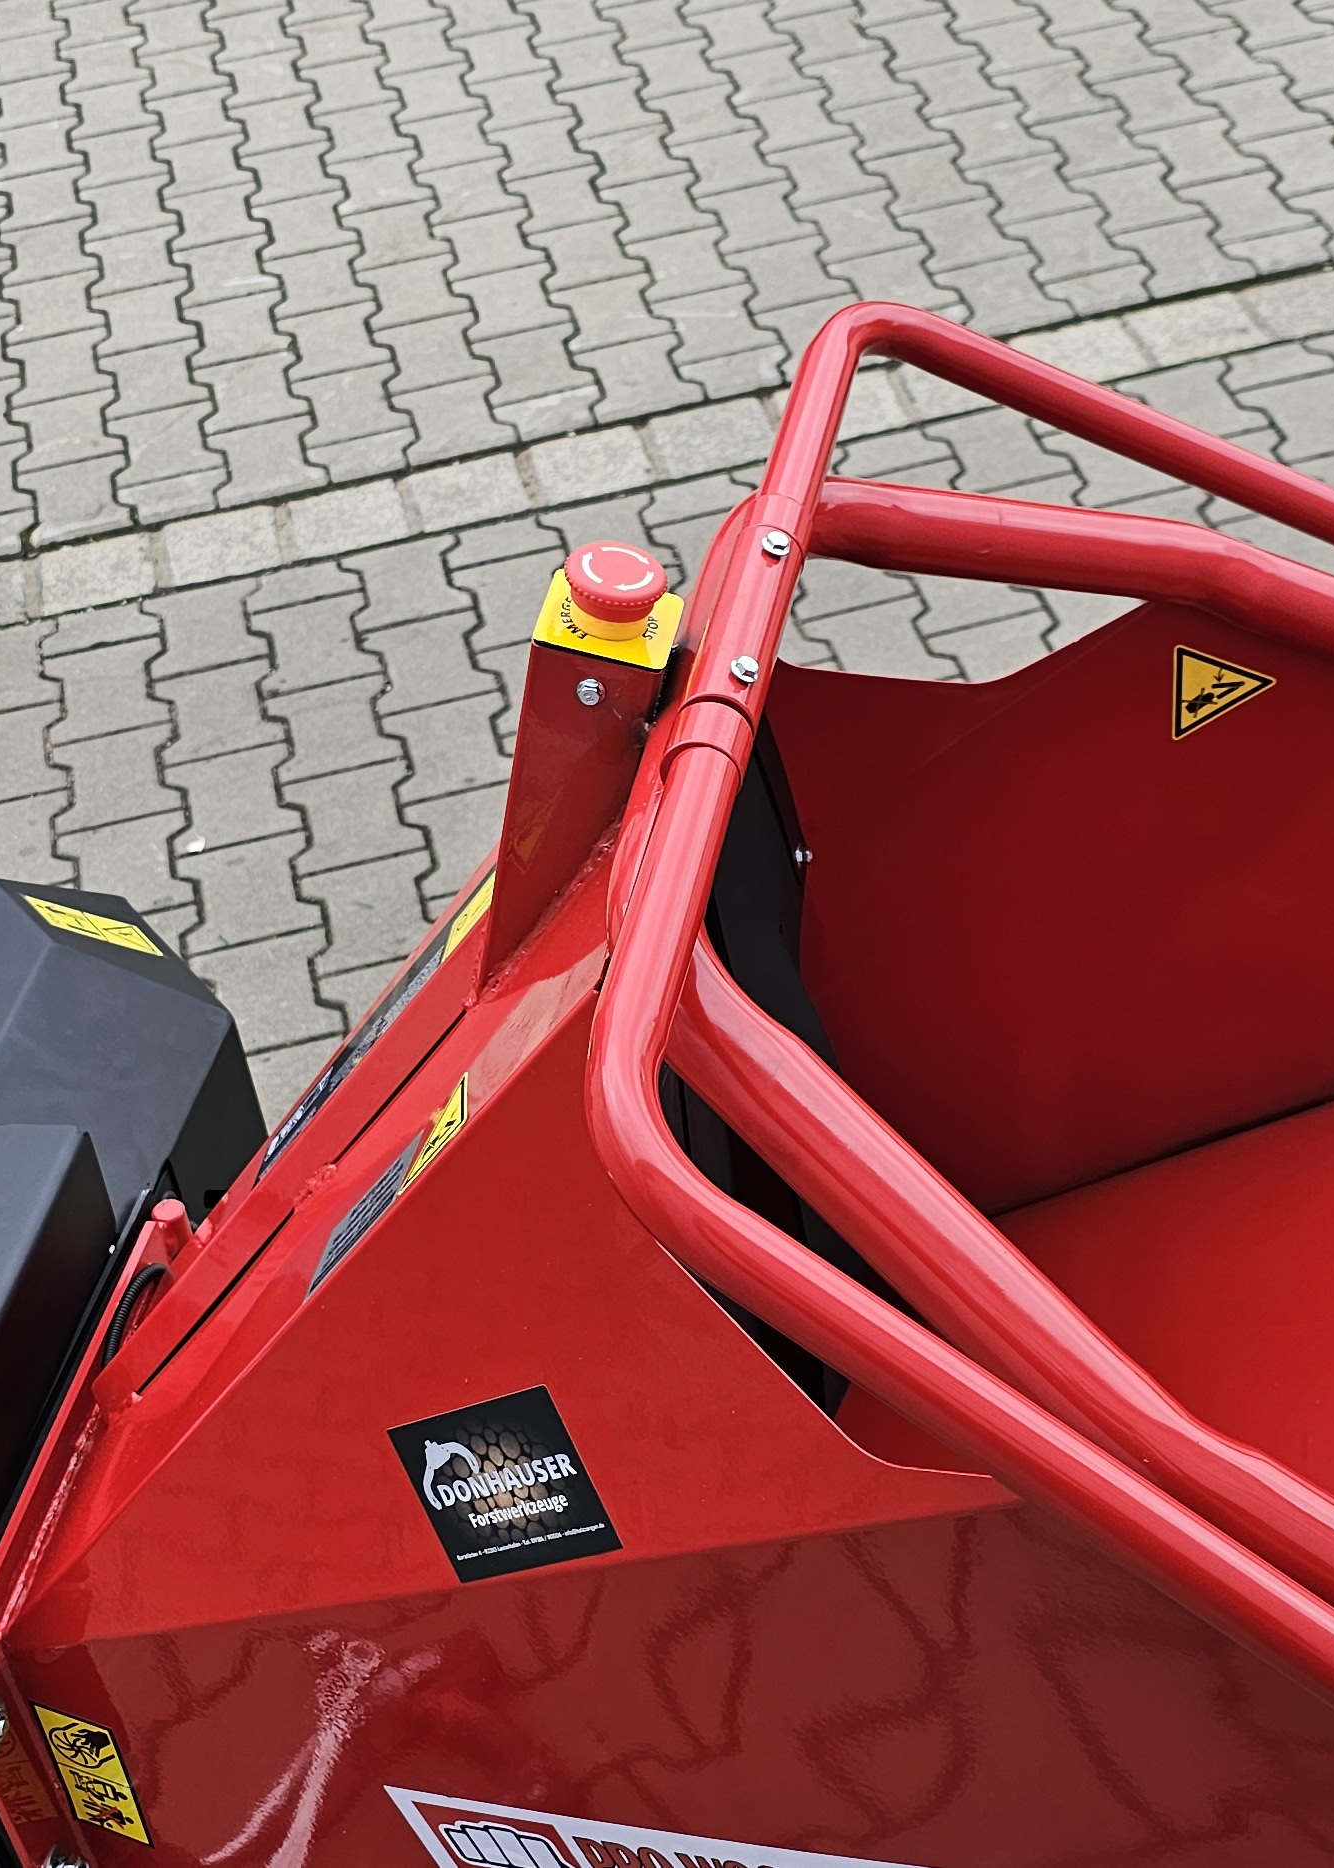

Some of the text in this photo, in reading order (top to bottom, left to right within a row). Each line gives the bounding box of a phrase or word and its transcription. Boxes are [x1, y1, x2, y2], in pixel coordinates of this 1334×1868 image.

[642, 615, 659, 640] STOP
[436, 1453, 578, 1507] DONHAUSER
[468, 1493, 569, 1528] Forstwerkzeuge
